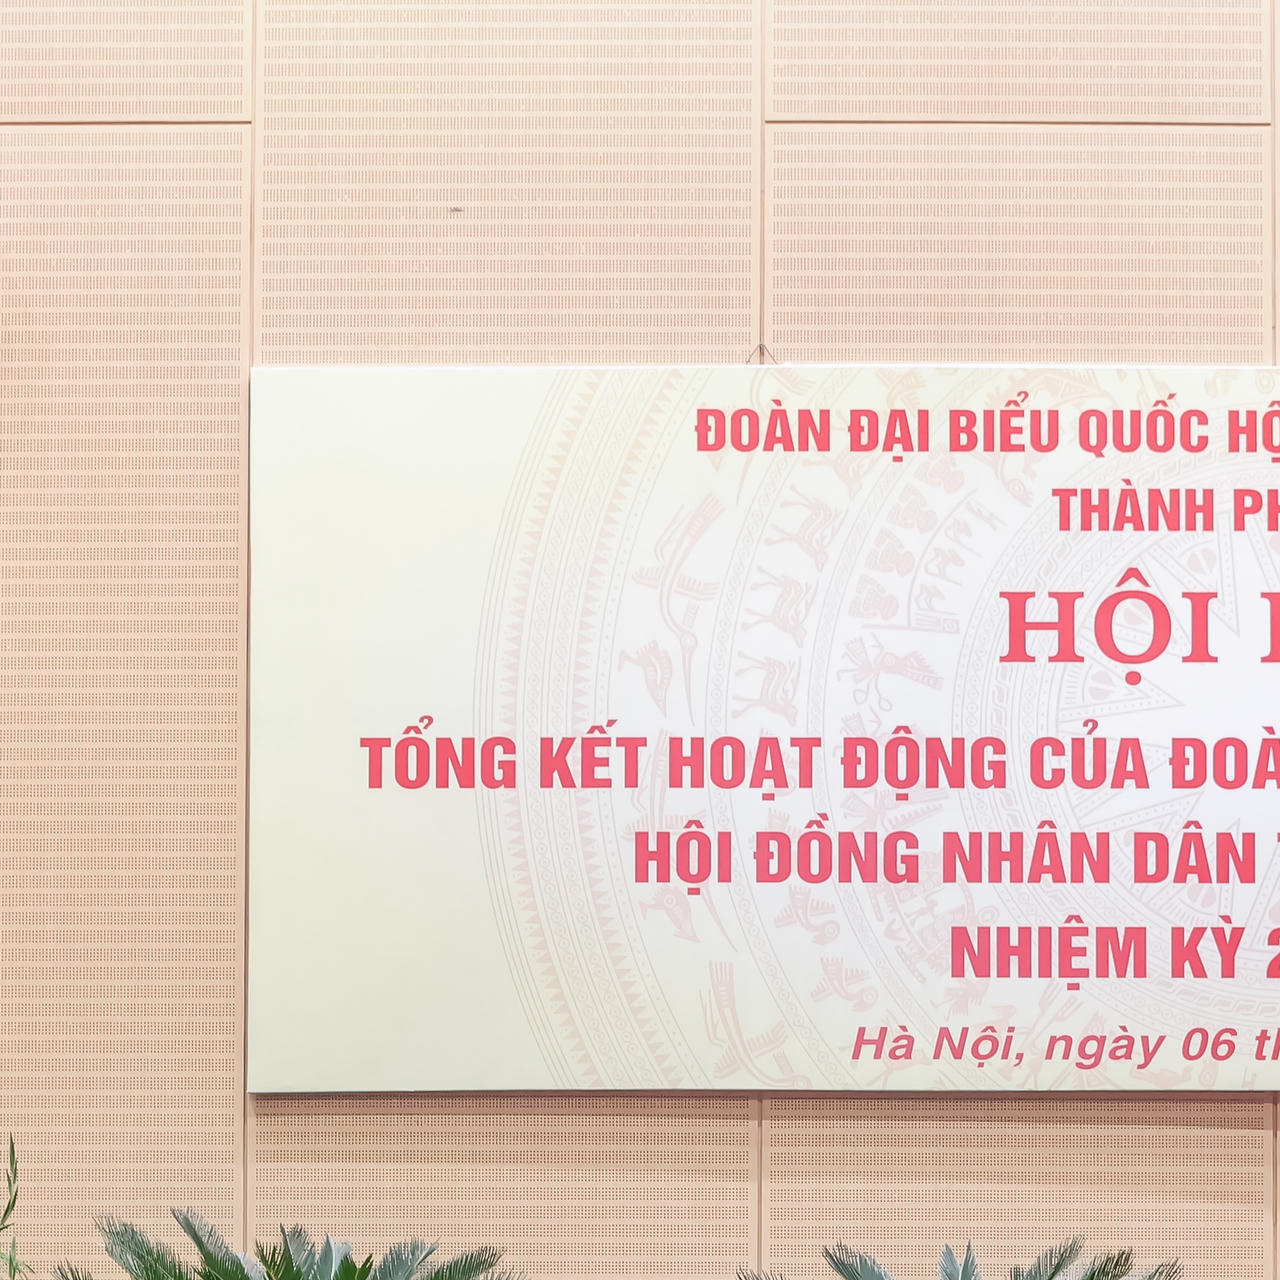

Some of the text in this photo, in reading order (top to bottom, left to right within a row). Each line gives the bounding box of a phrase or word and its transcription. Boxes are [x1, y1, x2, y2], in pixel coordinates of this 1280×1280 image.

[695, 399, 831, 453] ĐOÀN
[848, 409, 929, 463] ĐẠI
[949, 391, 1059, 453] BIỂU
[1079, 394, 1209, 458] QUỐC
[1052, 479, 1214, 532] THÀNH
[999, 567, 1218, 686] HỘI
[360, 715, 517, 790] TỔNG
[540, 719, 647, 789] KẾT
[669, 736, 822, 801] HOẠT
[841, 725, 1006, 801] ĐỘNG
[1030, 719, 1149, 790] CỦA
[635, 819, 732, 895] HỘI
[754, 813, 919, 884] ĐỒNG
[943, 819, 1110, 884] NHÂN
[1134, 820, 1256, 884] DÂN
[951, 914, 1147, 991] NHIỆM
[1171, 915, 1245, 979] KỲ
[853, 1025, 914, 1060] Hà
[934, 1026, 1023, 1067] Nội,
[1046, 1026, 1165, 1070] ngày
[1183, 1027, 1237, 1061] 06
